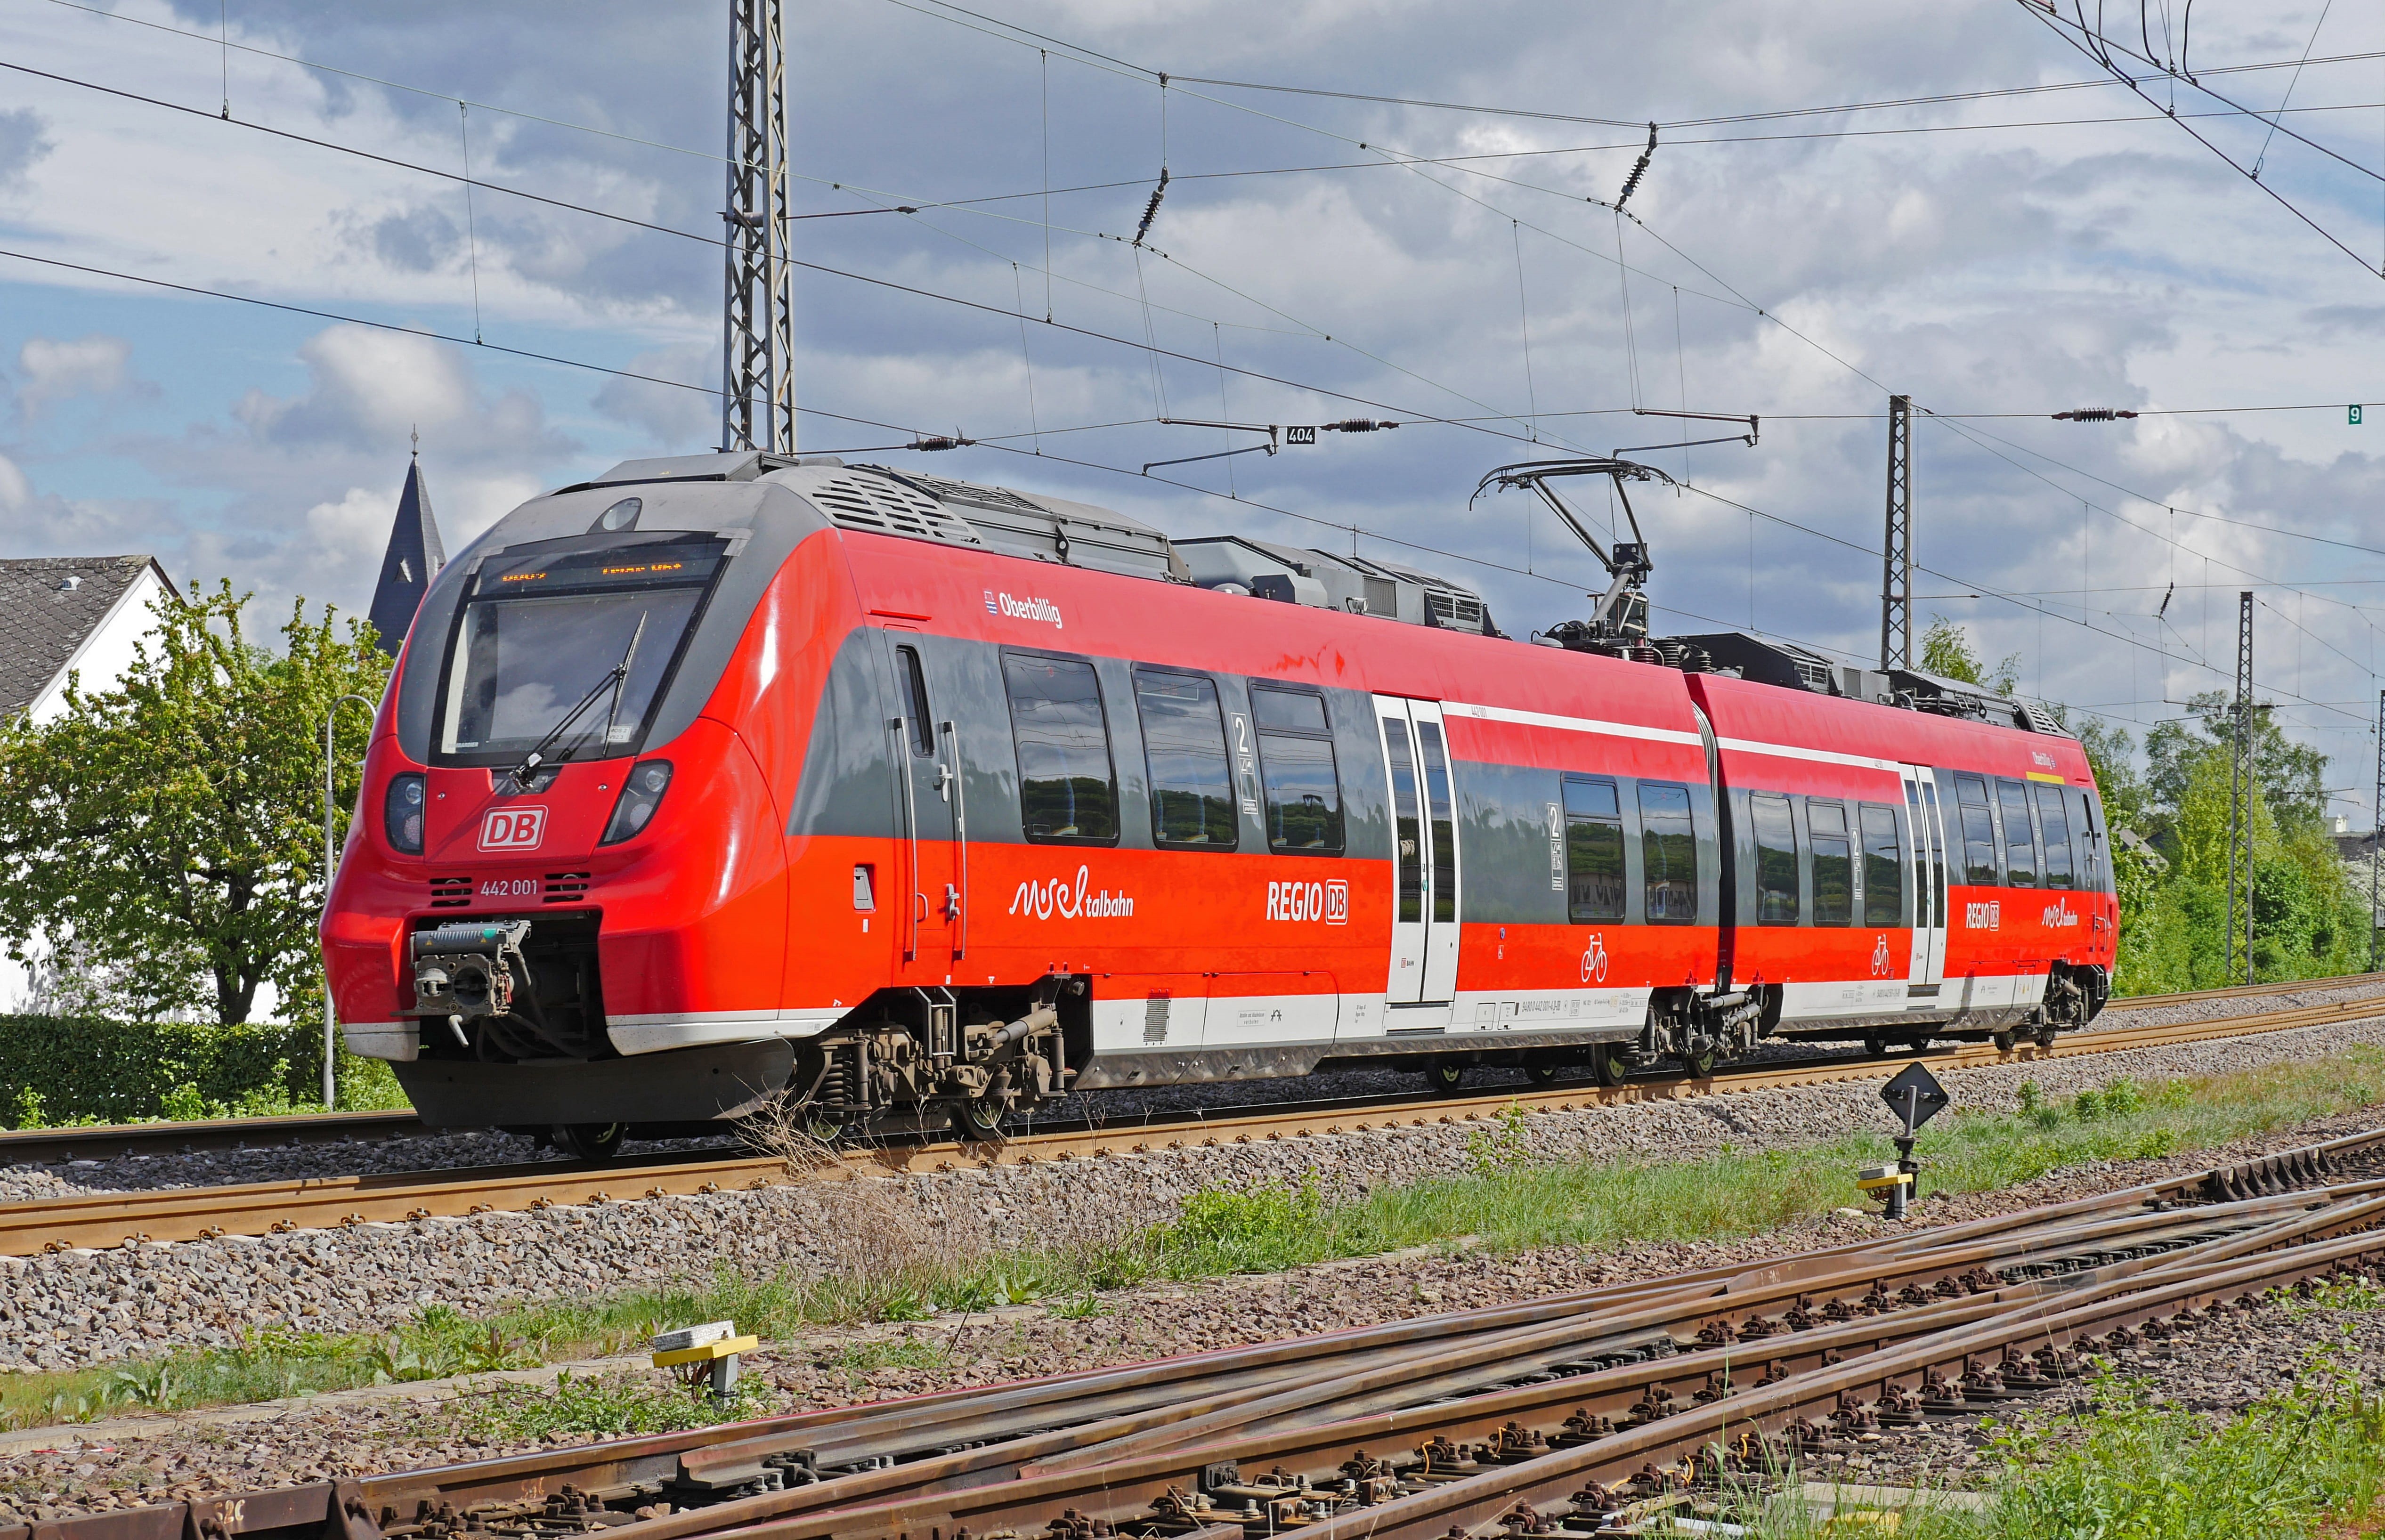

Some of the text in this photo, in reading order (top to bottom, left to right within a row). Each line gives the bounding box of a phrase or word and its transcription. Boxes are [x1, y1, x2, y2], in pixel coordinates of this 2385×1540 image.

[2351, 407, 2360, 421] 9
[1289, 428, 1313, 442] 404
[999, 592, 1063, 629] Oberbillig
[1235, 717, 1249, 753] 2
[1550, 806, 1559, 838] 2
[1993, 801, 2000, 824] 2
[2032, 806, 2038, 828] 1
[1852, 830, 1858, 856] 2
[480, 879, 537, 896] 442 001
[1266, 881, 1322, 922] REGIO
[1966, 903, 1989, 929] REGIO
